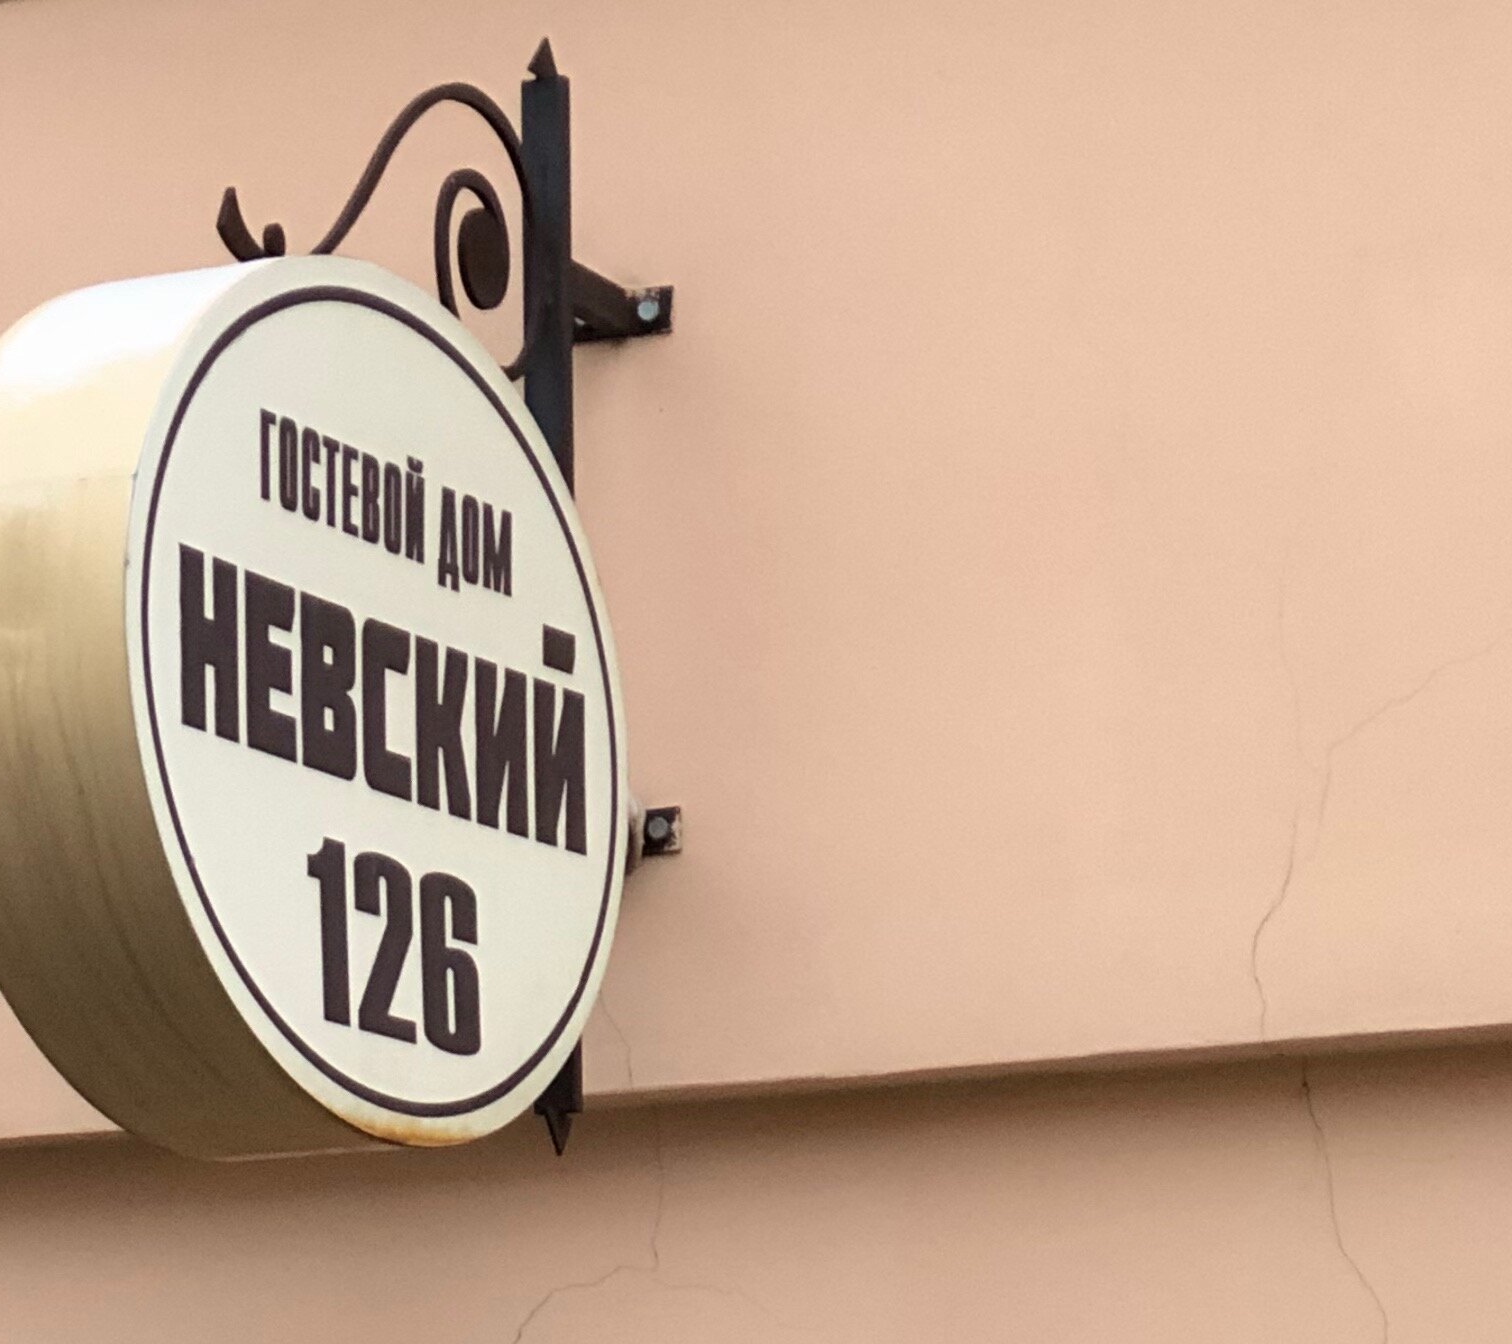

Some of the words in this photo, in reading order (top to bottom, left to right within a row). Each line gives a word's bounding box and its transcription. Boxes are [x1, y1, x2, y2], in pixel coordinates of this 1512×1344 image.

[259, 408, 425, 564] ГОСТЕВОЙ
[437, 486, 513, 597] ДОМ
[179, 542, 587, 857] НЕВСКИЙ
[306, 836, 482, 1057] 126
